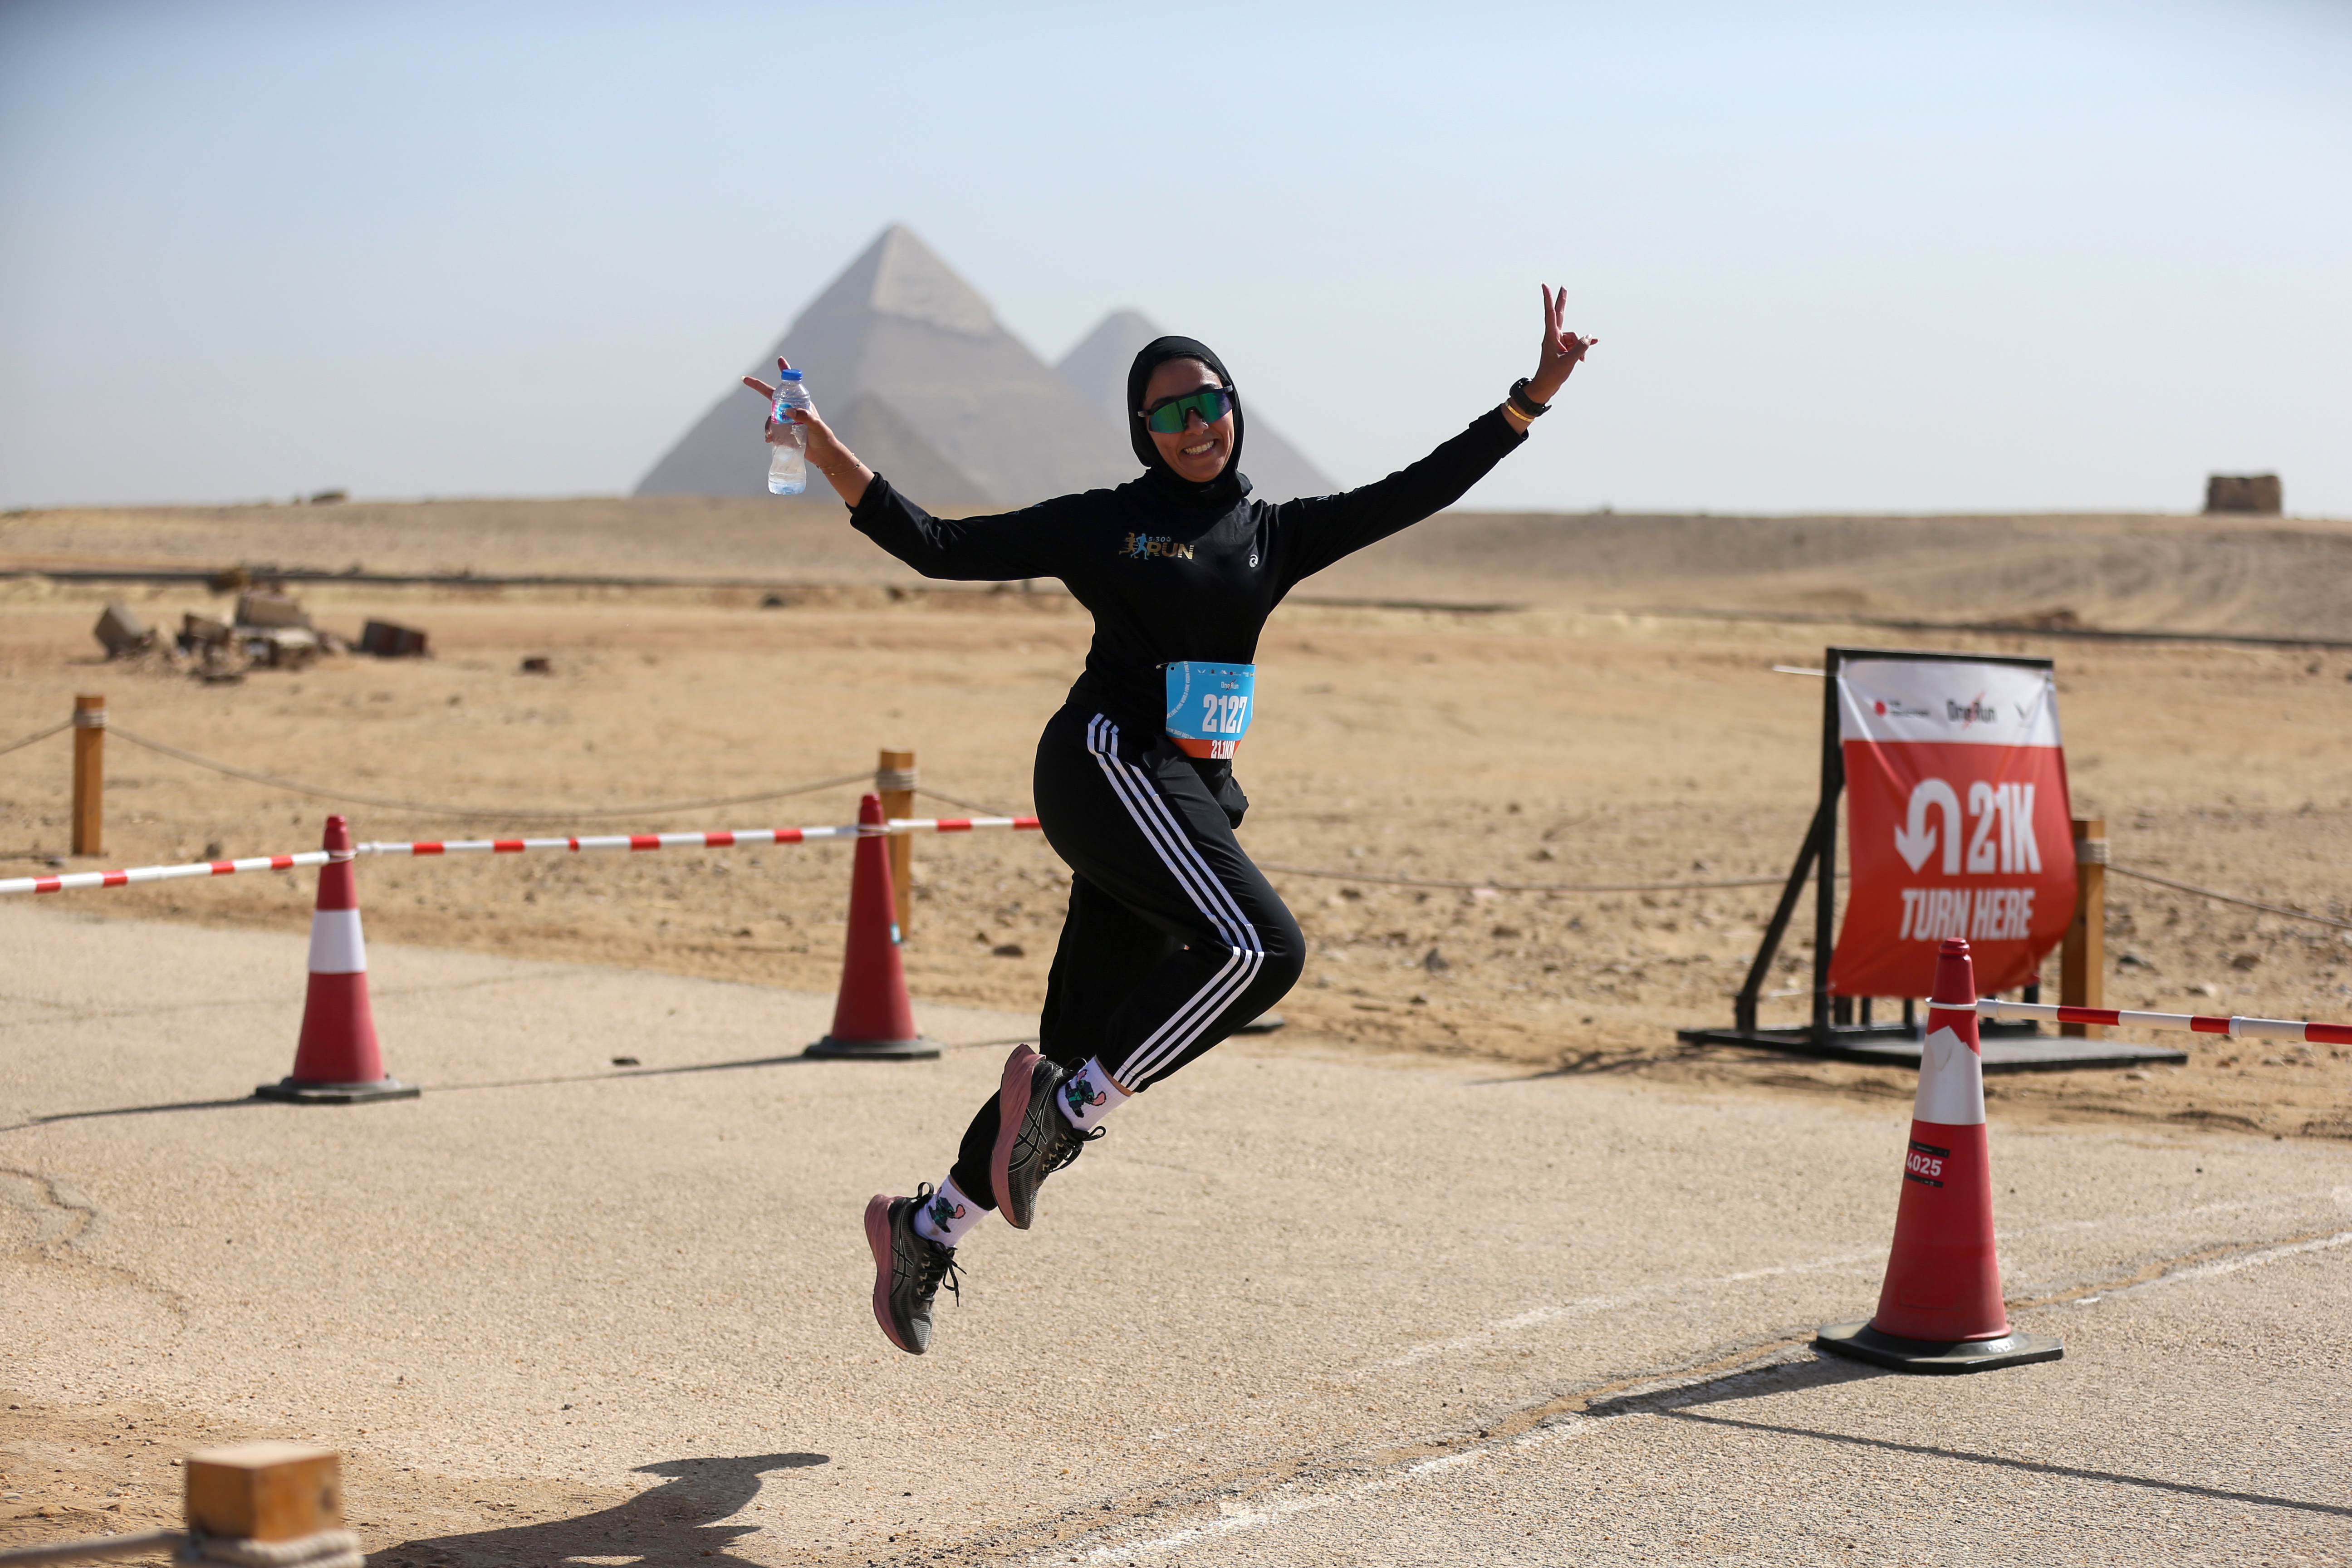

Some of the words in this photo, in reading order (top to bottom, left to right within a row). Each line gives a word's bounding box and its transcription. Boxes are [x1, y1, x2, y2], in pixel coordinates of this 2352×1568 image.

[1147, 541, 1194, 559] RUN
[1202, 694, 1248, 733] 2127
[1211, 740, 1235, 759] 21.1KM
[1967, 780, 2042, 874] 21K
[1900, 889, 1971, 940] TURN
[1971, 889, 2036, 939] HERE
[1906, 1153, 1942, 1176] 4025
